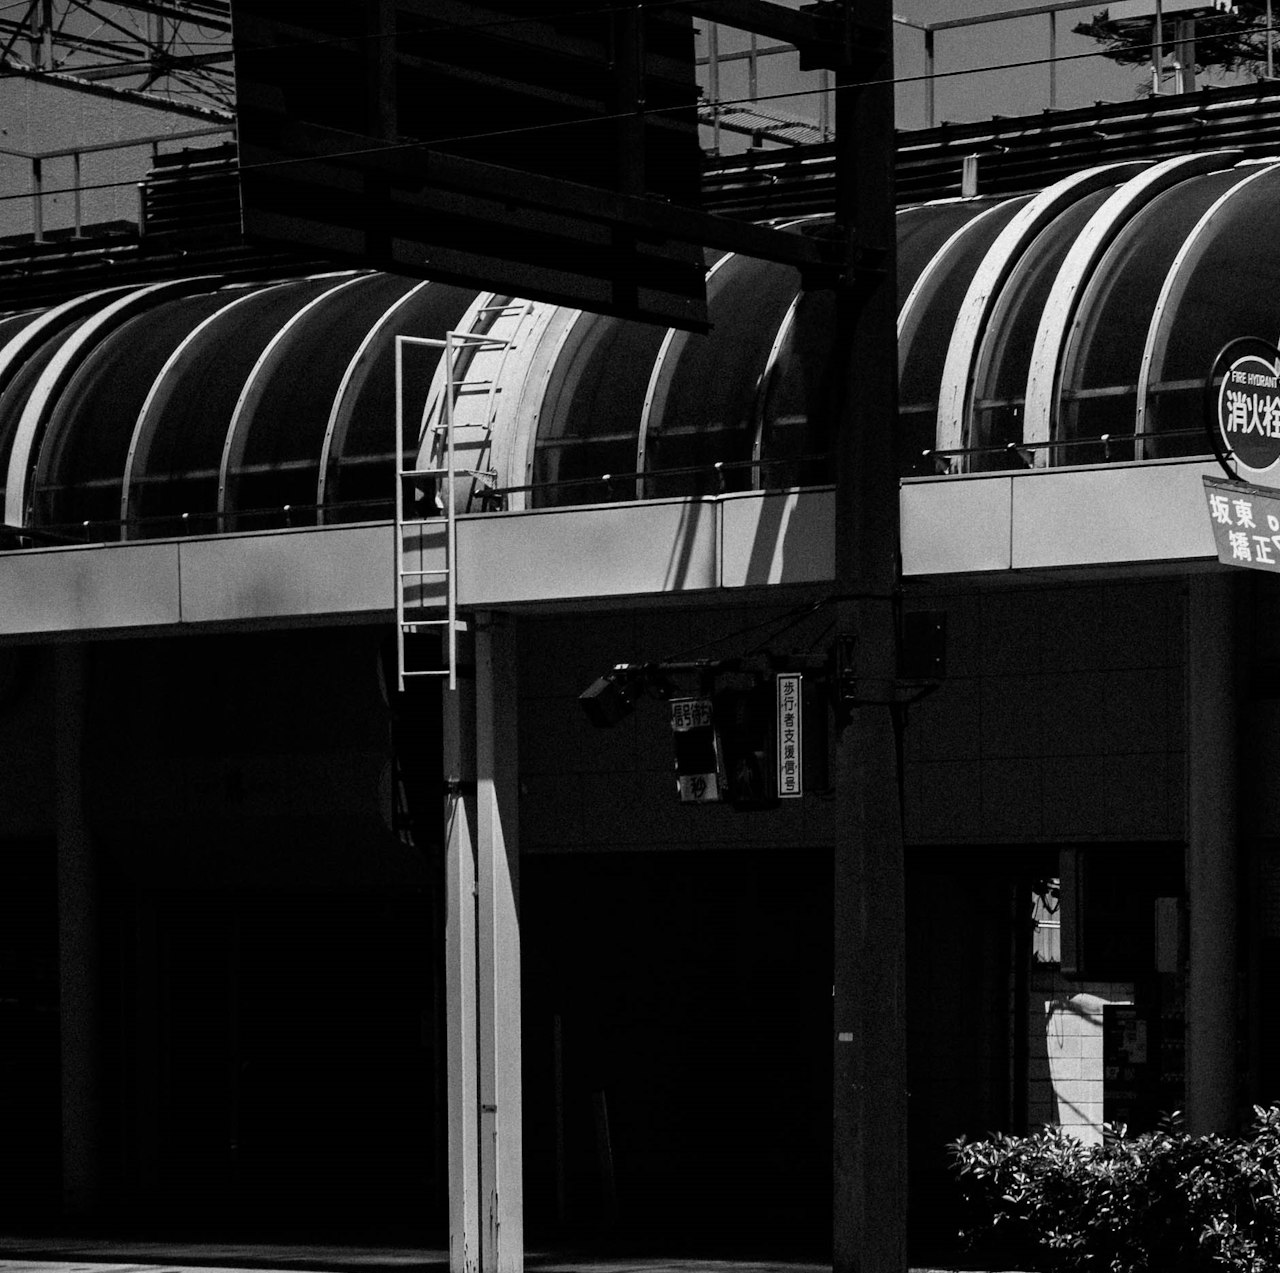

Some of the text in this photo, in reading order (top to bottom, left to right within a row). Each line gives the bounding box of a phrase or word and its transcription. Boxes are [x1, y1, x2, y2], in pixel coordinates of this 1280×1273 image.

[1231, 371, 1278, 389] FIRE HYDRANT
[1210, 493, 1256, 528] 坂東
[1228, 530, 1276, 565] 矯正
[782, 680, 796, 792] 歩行者支援信号
[690, 777, 707, 797] 秒
